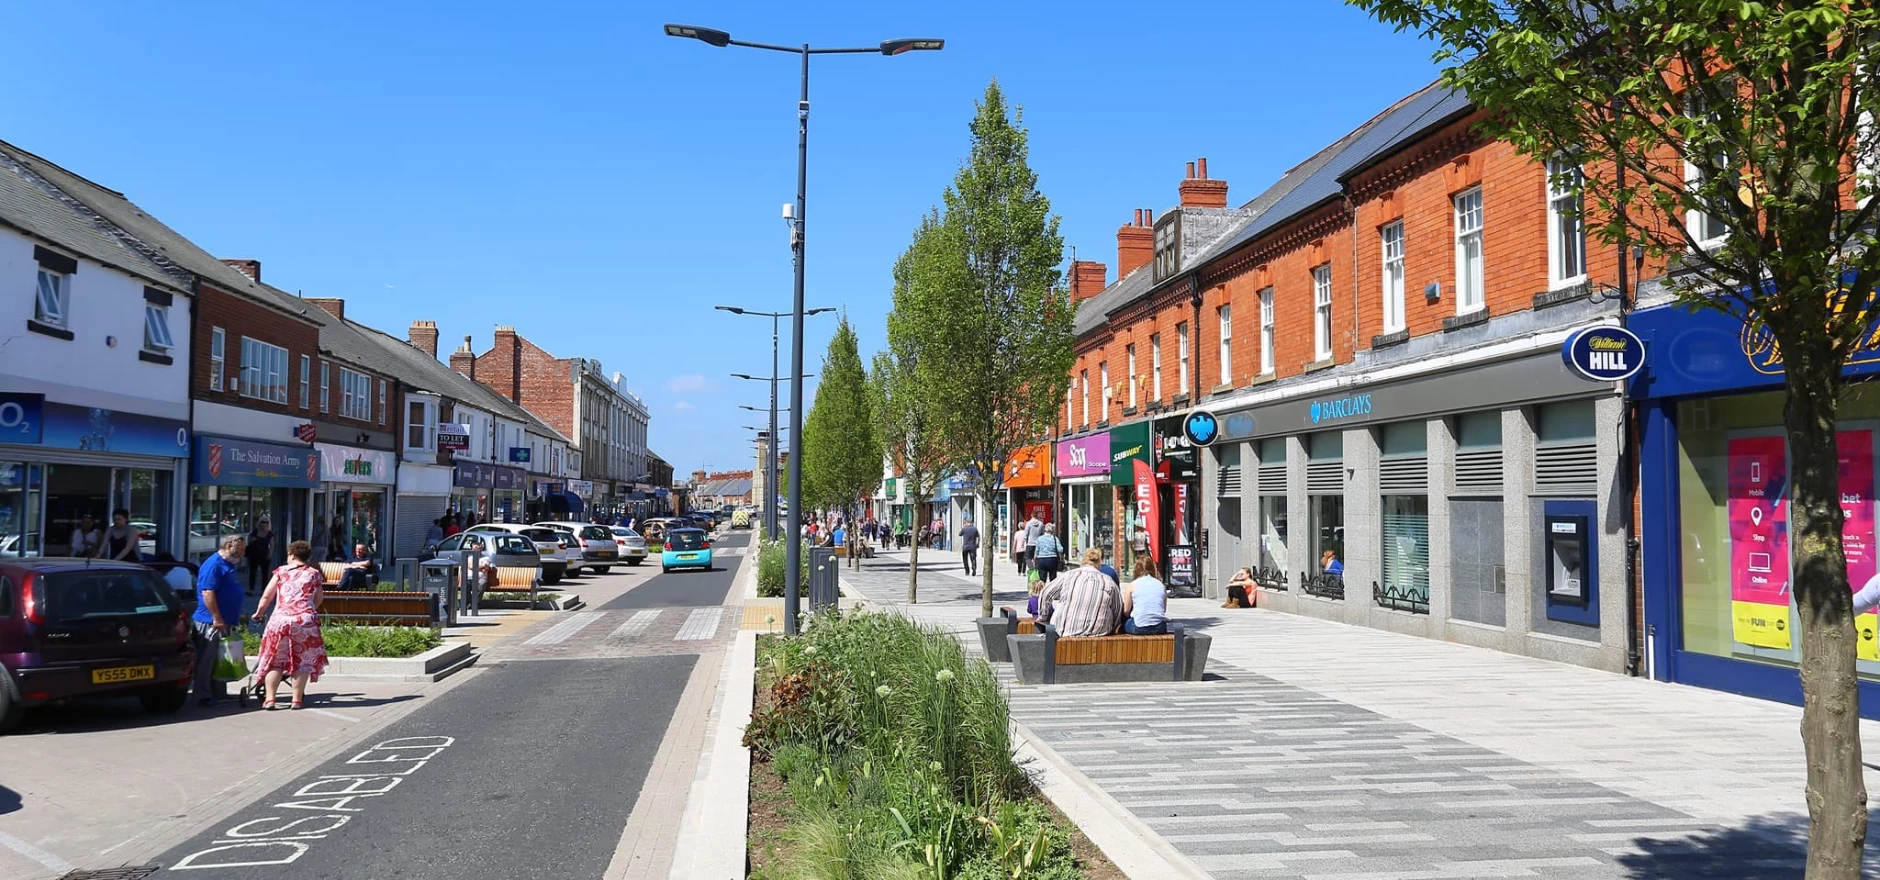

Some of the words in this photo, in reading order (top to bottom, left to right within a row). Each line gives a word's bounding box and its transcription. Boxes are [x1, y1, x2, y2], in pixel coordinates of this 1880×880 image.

[1589, 352, 1627, 370] HILL
[1322, 394, 1372, 420] BARCLAYS
[230, 448, 246, 462] The
[247, 450, 281, 465] Salvation
[282, 454, 300, 469] Army
[1112, 445, 1143, 462] SUBWAY
[1748, 488, 1765, 496] Mobile
[1842, 493, 1861, 504] bet
[1752, 533, 1765, 542] Shop
[1171, 548, 1192, 557] RED
[1752, 576, 1768, 584] Online
[130, 667, 151, 679] DMX
[169, 735, 455, 871] DISABLED
